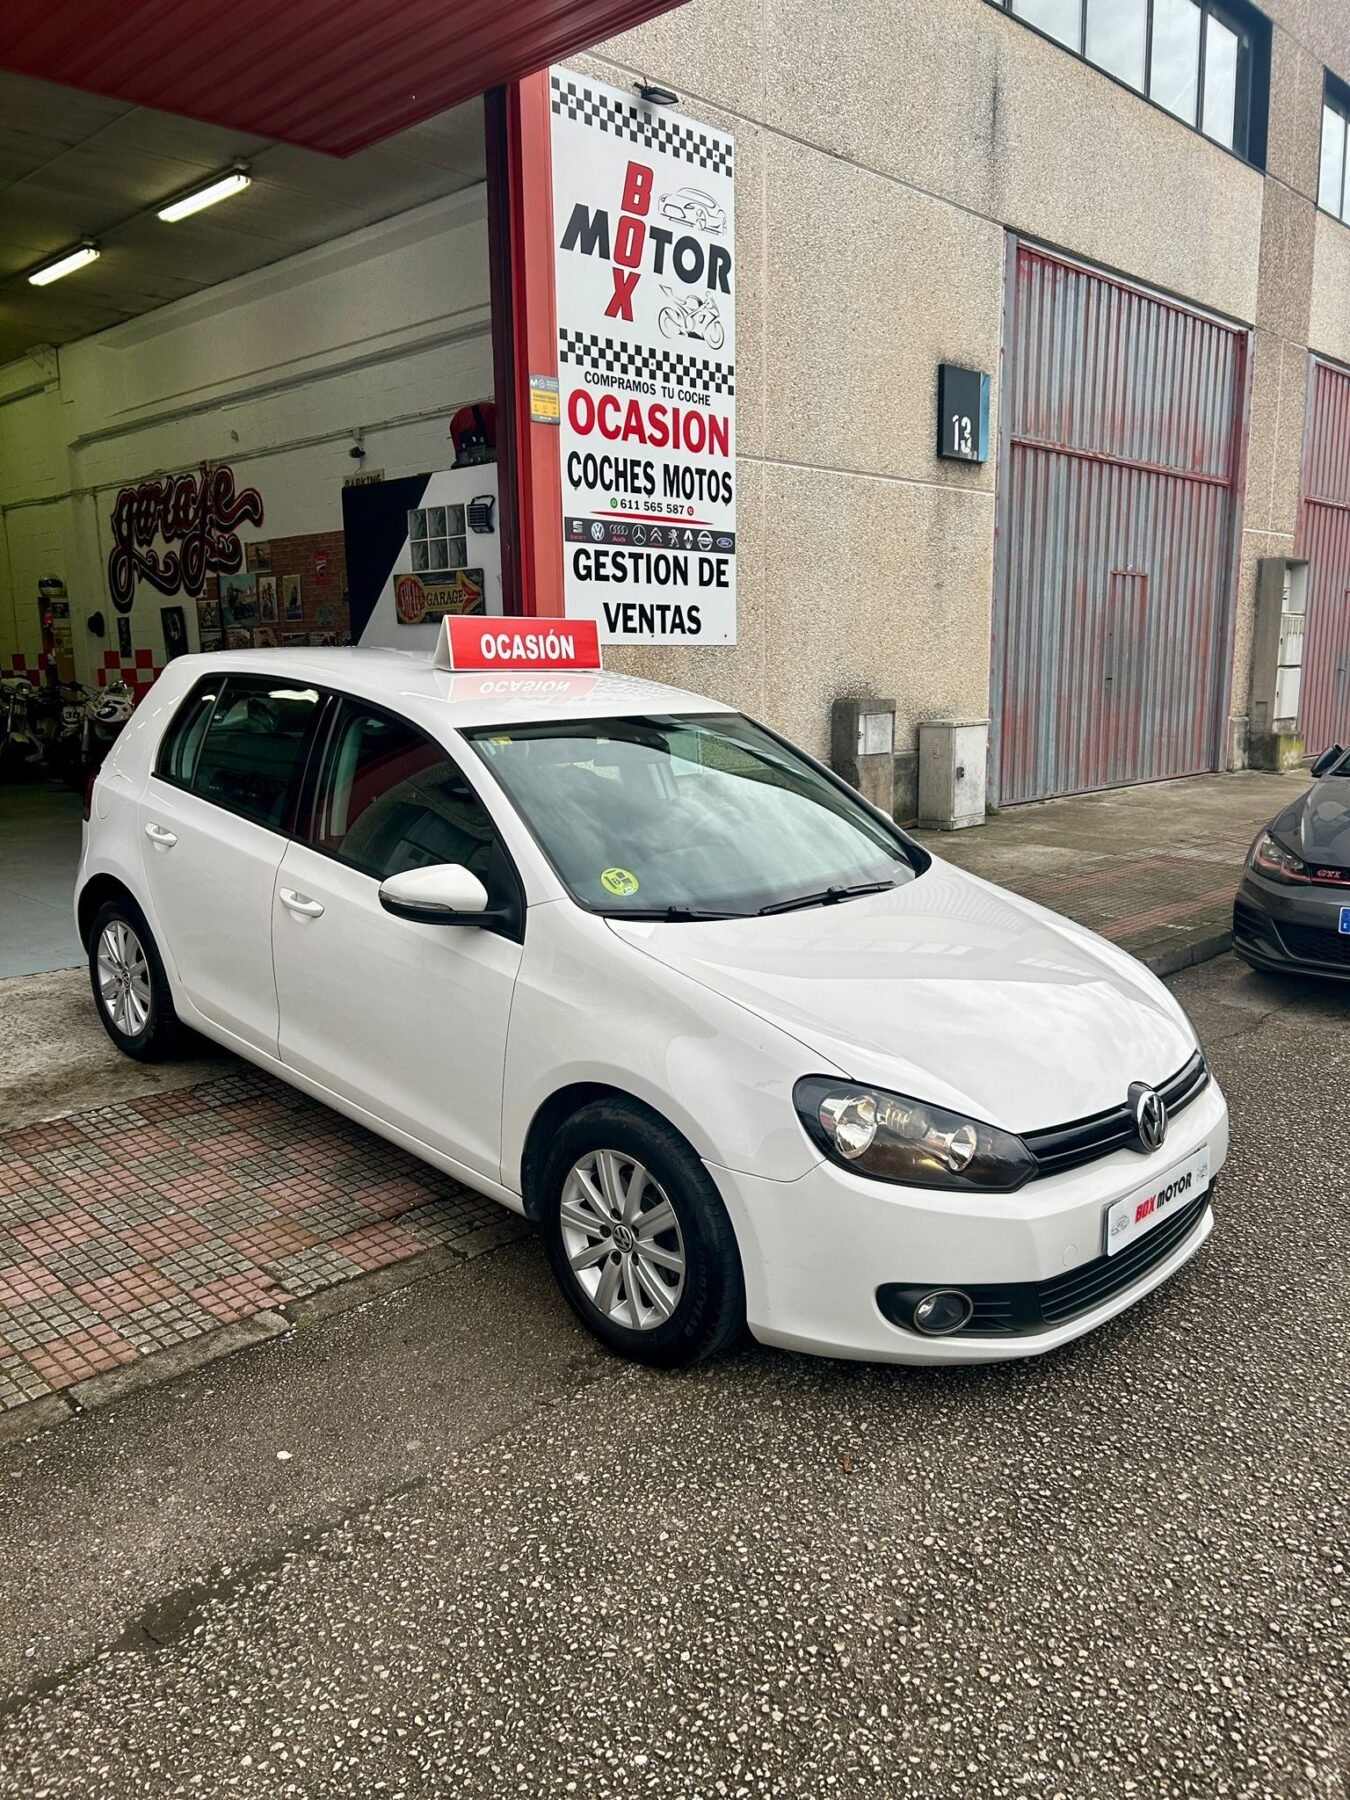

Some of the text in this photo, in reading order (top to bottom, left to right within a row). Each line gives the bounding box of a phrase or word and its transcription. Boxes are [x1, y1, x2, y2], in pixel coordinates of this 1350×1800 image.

[584, 371, 711, 406] COMPRAMOS TU COCHE
[568, 388, 729, 457] OCASION
[952, 415, 972, 454] 13
[567, 451, 732, 504] COCHES MOTOS
[620, 499, 685, 515] 611 565 587
[573, 548, 729, 588] GESTION DE
[426, 590, 464, 607] GARAGE
[603, 602, 701, 635] VENTAS
[480, 629, 575, 660] OCASIÓN
[1134, 1172, 1192, 1224] BOX MOTOR
